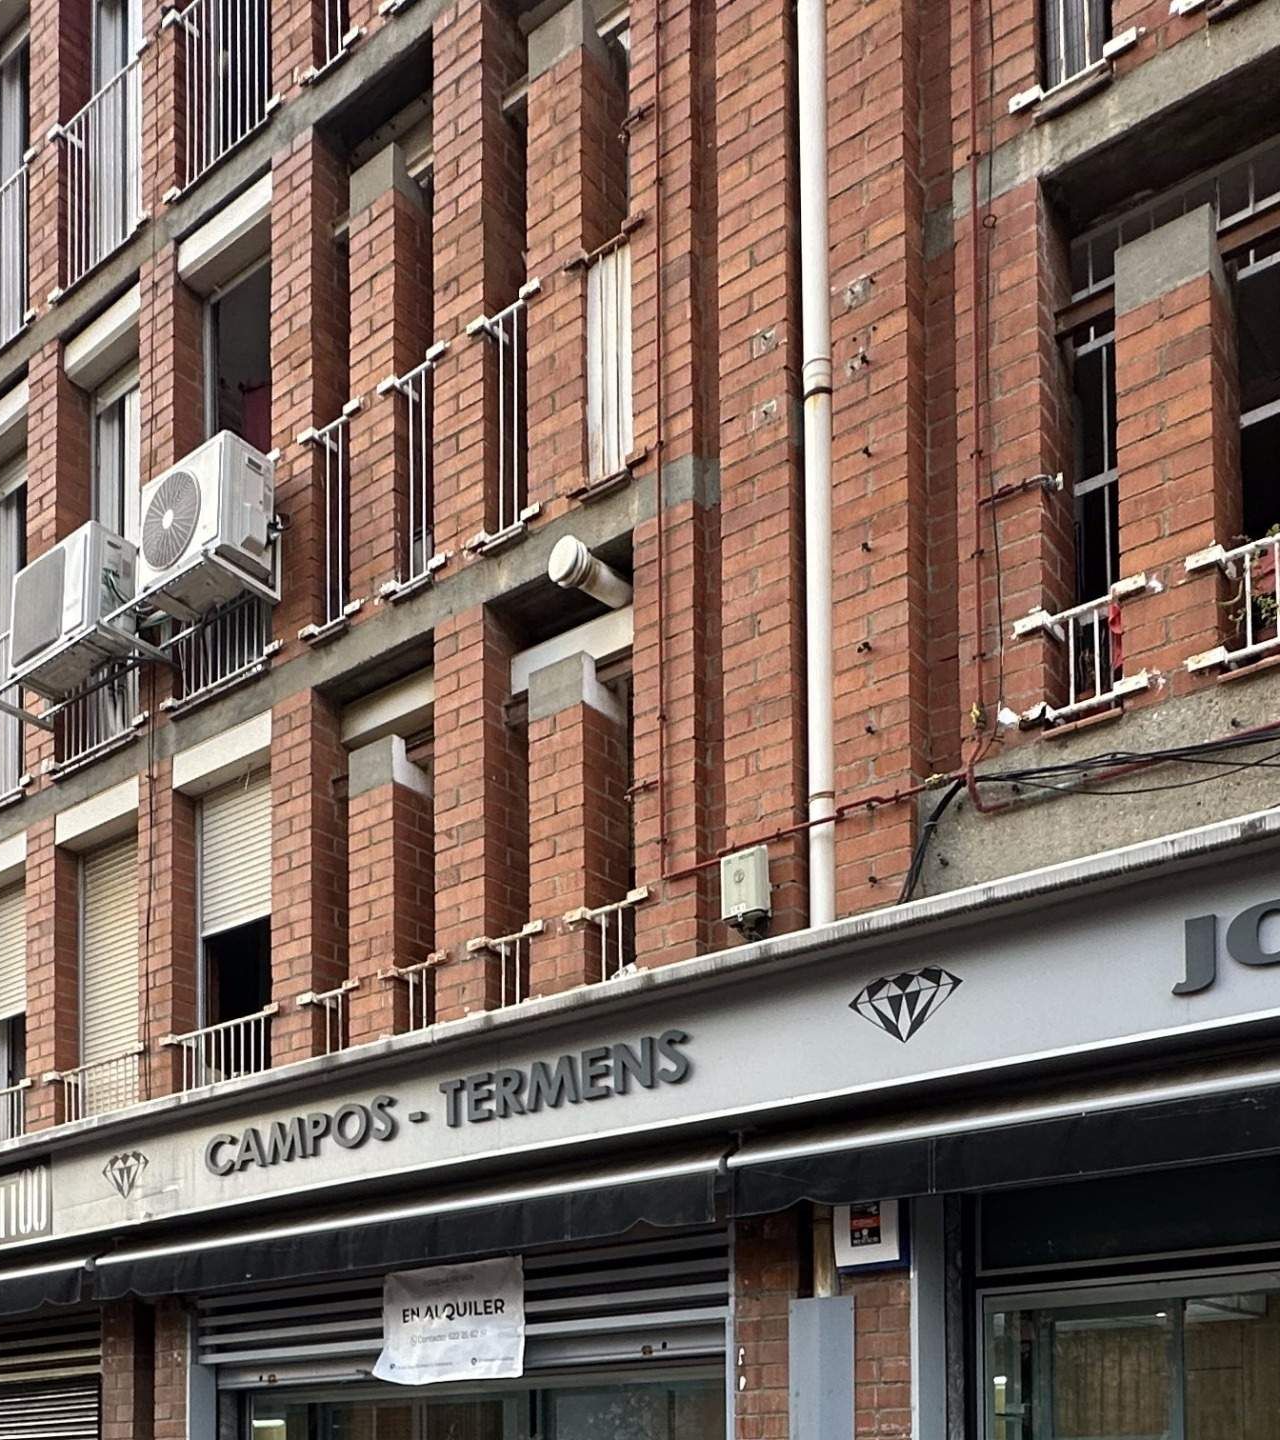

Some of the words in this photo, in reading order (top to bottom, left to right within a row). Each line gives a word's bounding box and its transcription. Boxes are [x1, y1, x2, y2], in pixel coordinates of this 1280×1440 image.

[205, 1095, 399, 1177] CAMPOS
[439, 1029, 694, 1128] TERMENS
[402, 1307, 420, 1324] EN
[424, 1298, 505, 1322] ALQUILER
